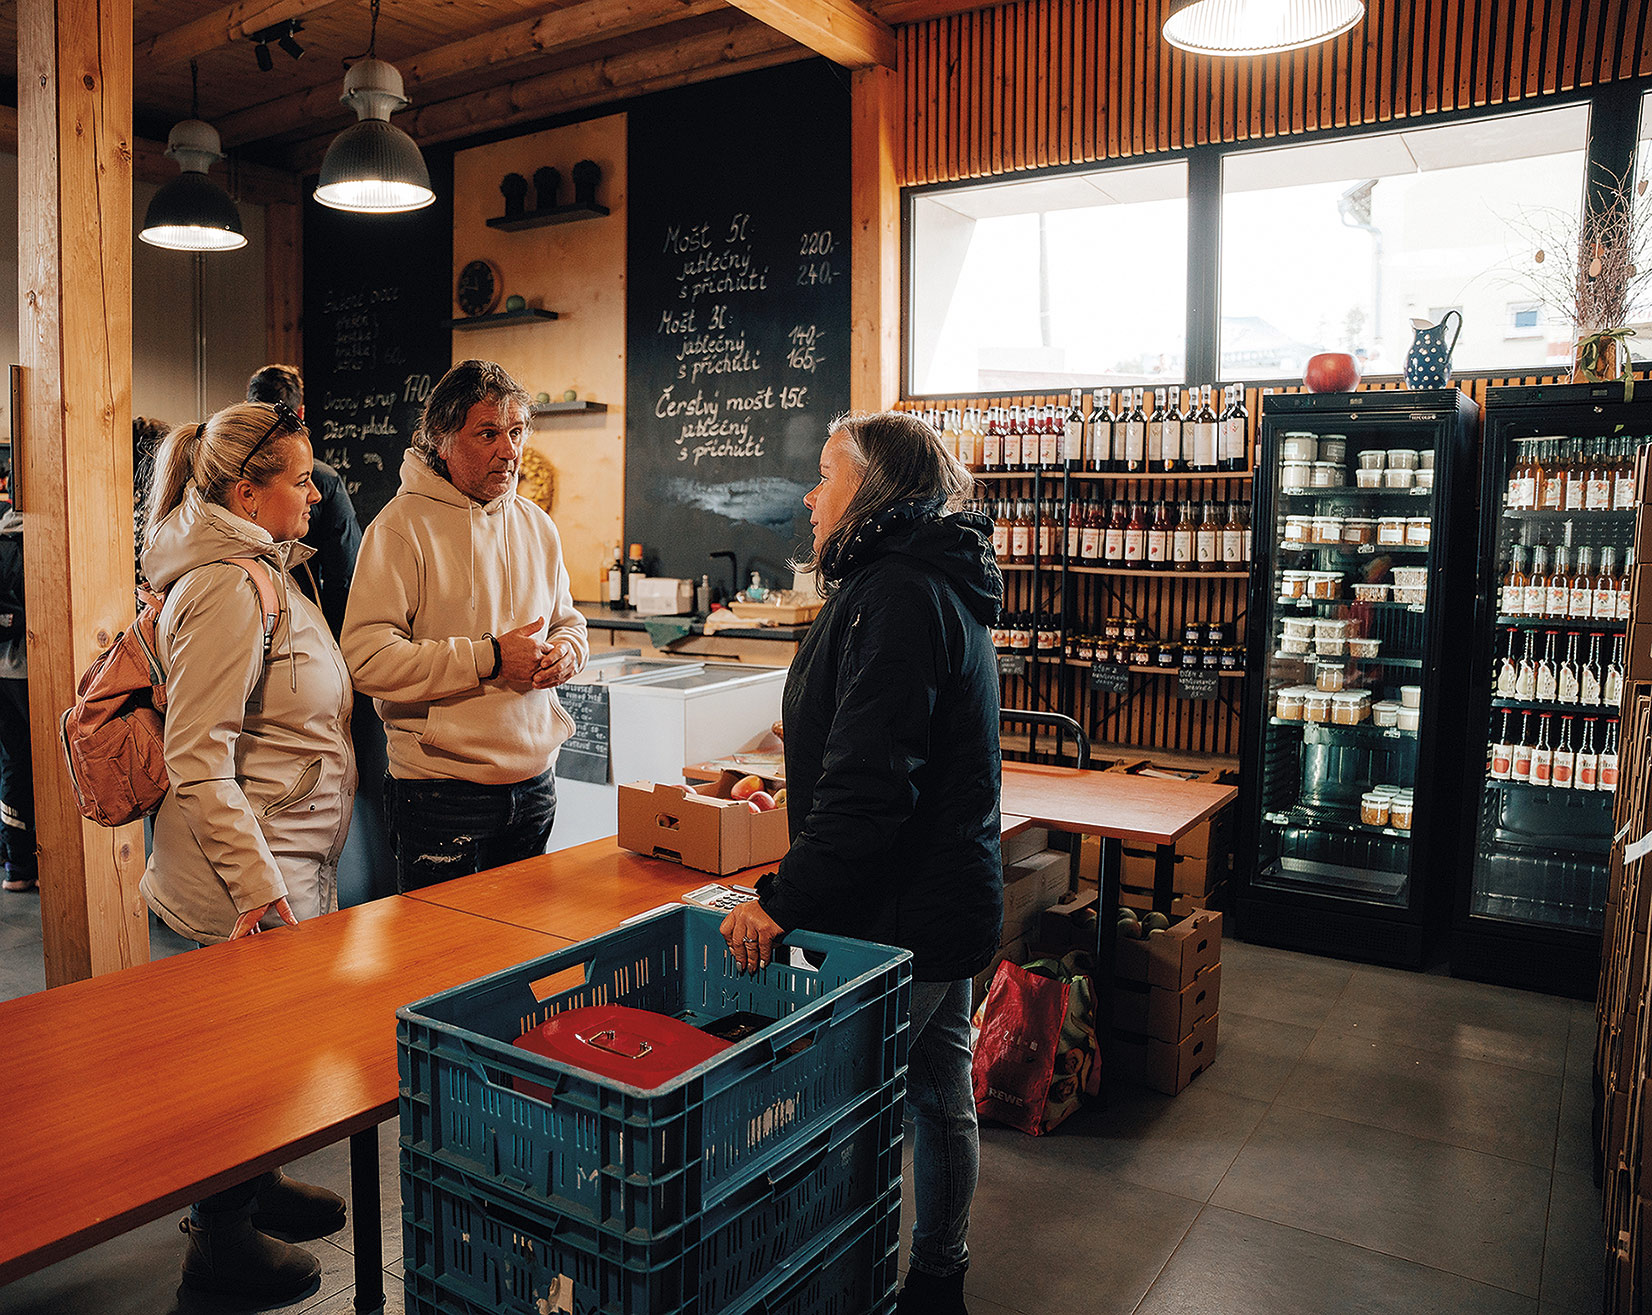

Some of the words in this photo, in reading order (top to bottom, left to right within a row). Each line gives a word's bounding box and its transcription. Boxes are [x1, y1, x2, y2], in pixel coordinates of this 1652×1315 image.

[663, 221, 712, 254] Mošt
[679, 285, 688, 299] s
[658, 309, 698, 334] Mošt
[677, 363, 687, 379] s
[726, 386, 776, 411] mošt
[677, 446, 689, 461] s
[988, 1086, 1024, 1108] REWE
